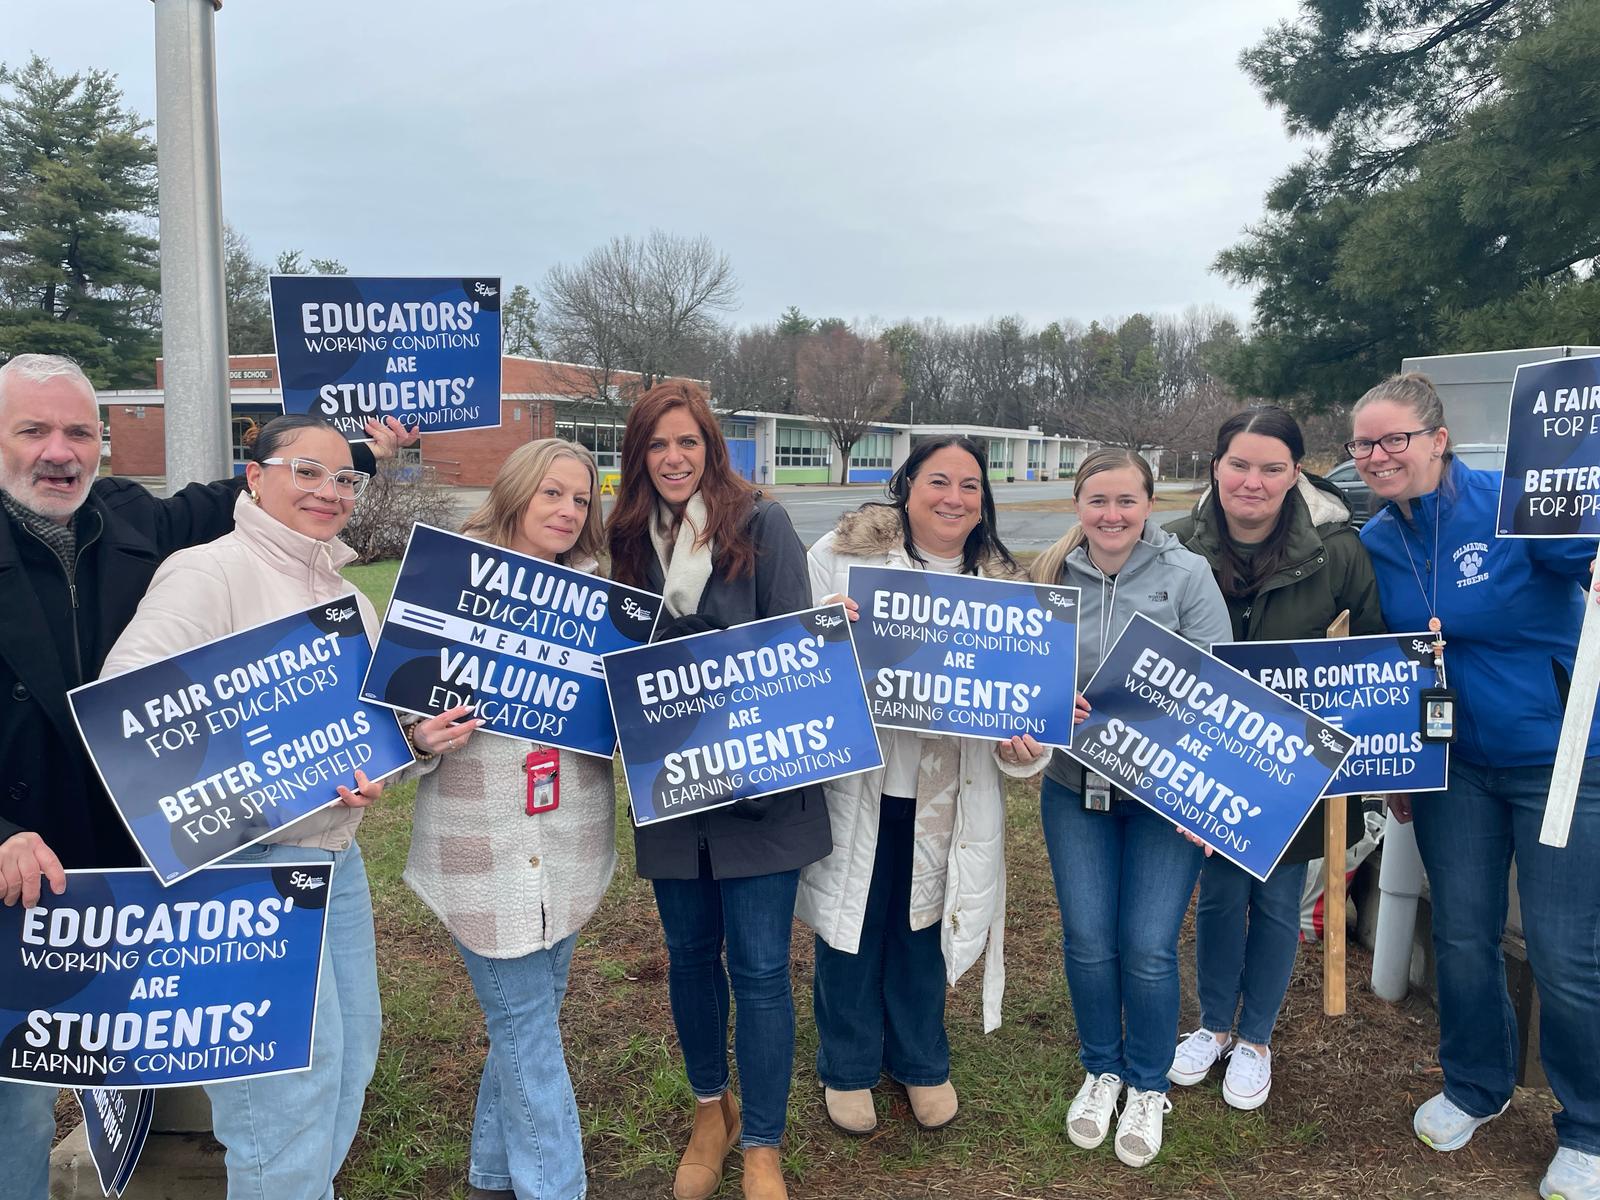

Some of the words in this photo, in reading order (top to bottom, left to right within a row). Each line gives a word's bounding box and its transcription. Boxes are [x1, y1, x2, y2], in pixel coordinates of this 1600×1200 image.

[302, 301, 480, 335] EDUCATORS'
[304, 336, 387, 353] WORKING
[392, 333, 480, 350] CONDITIONS
[243, 371, 268, 379] SCHOOL
[386, 356, 417, 374] ARE
[320, 376, 475, 415] STUDENTS'
[1532, 390, 1548, 415] A
[1554, 385, 1600, 413] FAIR
[397, 405, 480, 427] CONDITIONS
[1543, 416, 1584, 438] FOR
[1525, 466, 1600, 493] BETTER
[1529, 497, 1567, 517] FOR
[470, 552, 608, 622] VALUING
[1456, 572, 1489, 588] TIGERS
[325, 608, 347, 622] SEA
[620, 597, 642, 619] SEA
[873, 590, 1053, 637] EDUCATORS'
[1048, 591, 1066, 607] SEA
[457, 589, 596, 648] EDUCATION
[815, 614, 836, 629] SEA
[470, 626, 570, 666] MEANS
[873, 621, 948, 644] WORKING
[953, 632, 1051, 656] CONDITIONS
[1411, 639, 1430, 655] SEA
[636, 635, 825, 705] EDUCATORS'
[943, 651, 976, 669] ARE
[1260, 667, 1309, 690] FAIR
[1313, 660, 1420, 689] CONTRACT
[122, 710, 144, 738] A
[145, 684, 212, 728] FAIR
[213, 632, 342, 700] CONTRACT
[440, 647, 580, 711] VALUING
[643, 693, 725, 724] WORKING
[731, 668, 832, 703] CONDITIONS
[876, 668, 1042, 713] STUDENTS'
[145, 721, 200, 758] FOR
[206, 665, 338, 734] EDUCATORS
[428, 685, 568, 736] EDUCATORS
[1132, 647, 1315, 764] EDUCATORS'
[1300, 686, 1410, 711] EDUCATORS
[728, 707, 762, 729] ARE
[948, 709, 1047, 734] CONDITIONS
[1124, 674, 1196, 725] WORKING
[1199, 721, 1296, 786] CONDITIONS
[664, 715, 834, 785] STUDENTS'
[1176, 733, 1213, 762] ARE
[1317, 728, 1337, 749] SEA
[1349, 731, 1423, 756] HOOLS
[158, 762, 263, 824] BETTER
[262, 711, 371, 776] SCHOOLS
[661, 773, 743, 808] LEARNING
[748, 747, 851, 784] CONDITIONS
[1099, 718, 1262, 825] STUDENTS'
[1335, 757, 1416, 781] NGFIELD
[182, 806, 235, 843] FOR
[239, 743, 373, 819] SPRINGFIELD
[1080, 738, 1153, 790] LEARNING
[1155, 786, 1252, 853] CONDITIONS
[290, 870, 314, 890] SEA
[22, 896, 294, 948] EDUCATORS'
[21, 947, 139, 973] WORKING
[148, 939, 289, 968] CONDITIONS
[130, 975, 181, 1000] ARE
[24, 999, 271, 1051] STUDENTS'
[11, 1048, 126, 1076] LEARNING
[134, 1040, 277, 1074] CONDITIONS
